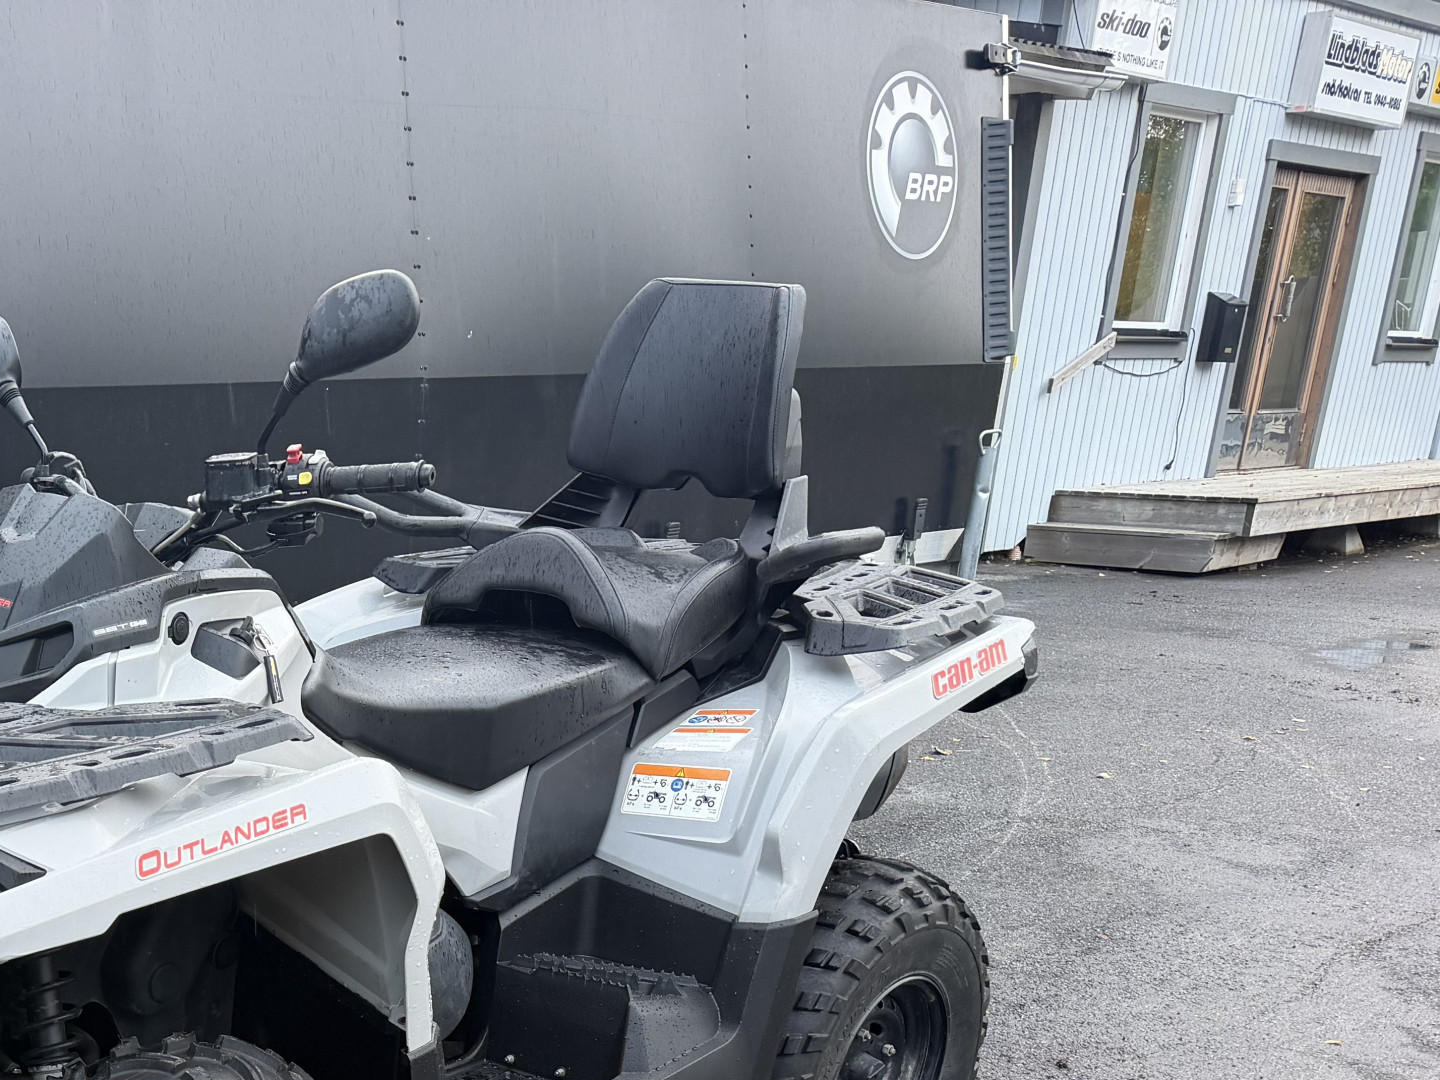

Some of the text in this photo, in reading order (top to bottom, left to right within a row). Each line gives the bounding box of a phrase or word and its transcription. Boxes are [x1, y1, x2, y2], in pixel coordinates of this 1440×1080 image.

[1122, 52, 1146, 67] NOTHING
[1146, 56, 1158, 70] LIKE
[1158, 61, 1164, 70] IT
[1325, 30, 1414, 84] Lindblads Motor
[1363, 91, 1373, 104] TEL
[905, 172, 953, 203] BRP
[932, 638, 1008, 698] can-am
[138, 803, 307, 878] OUTLANDER
